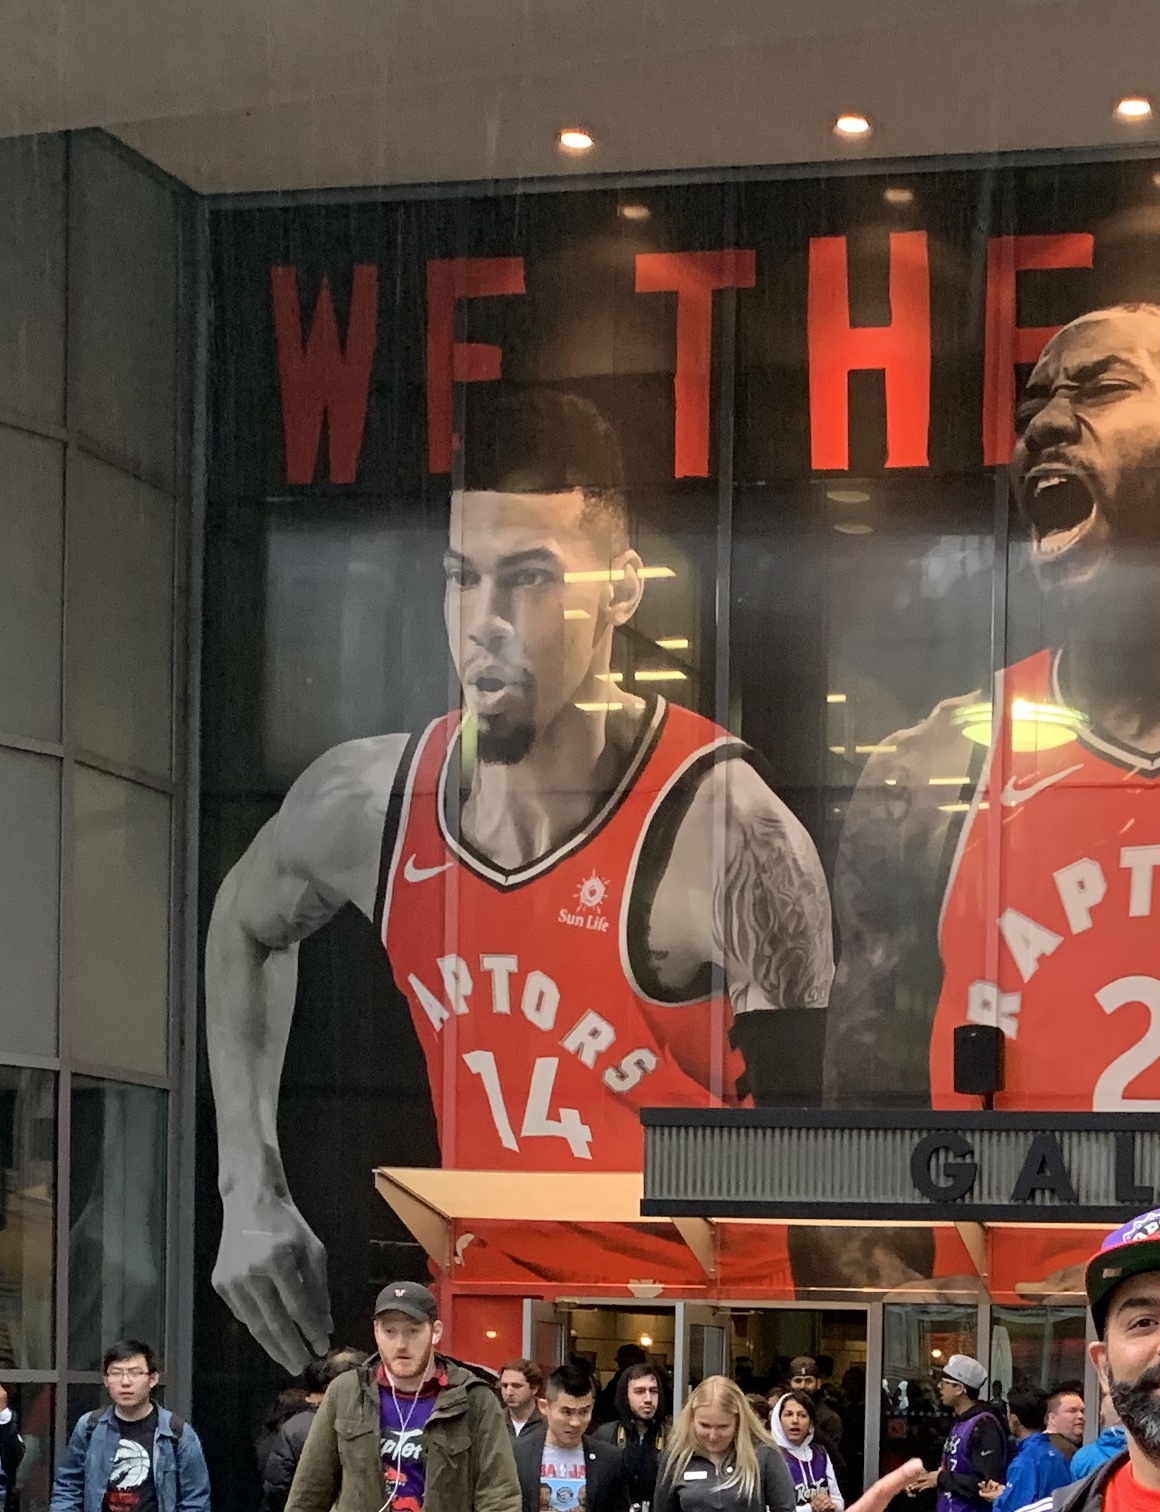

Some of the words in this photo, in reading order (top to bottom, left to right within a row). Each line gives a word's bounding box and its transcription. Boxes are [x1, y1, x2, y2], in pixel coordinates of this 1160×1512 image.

[271, 256, 526, 485] WE
[634, 230, 1094, 478] THE
[558, 908, 584, 927] Sun
[586, 914, 609, 932] Life
[408, 953, 660, 1094] APTORS
[462, 1050, 593, 1160] 14
